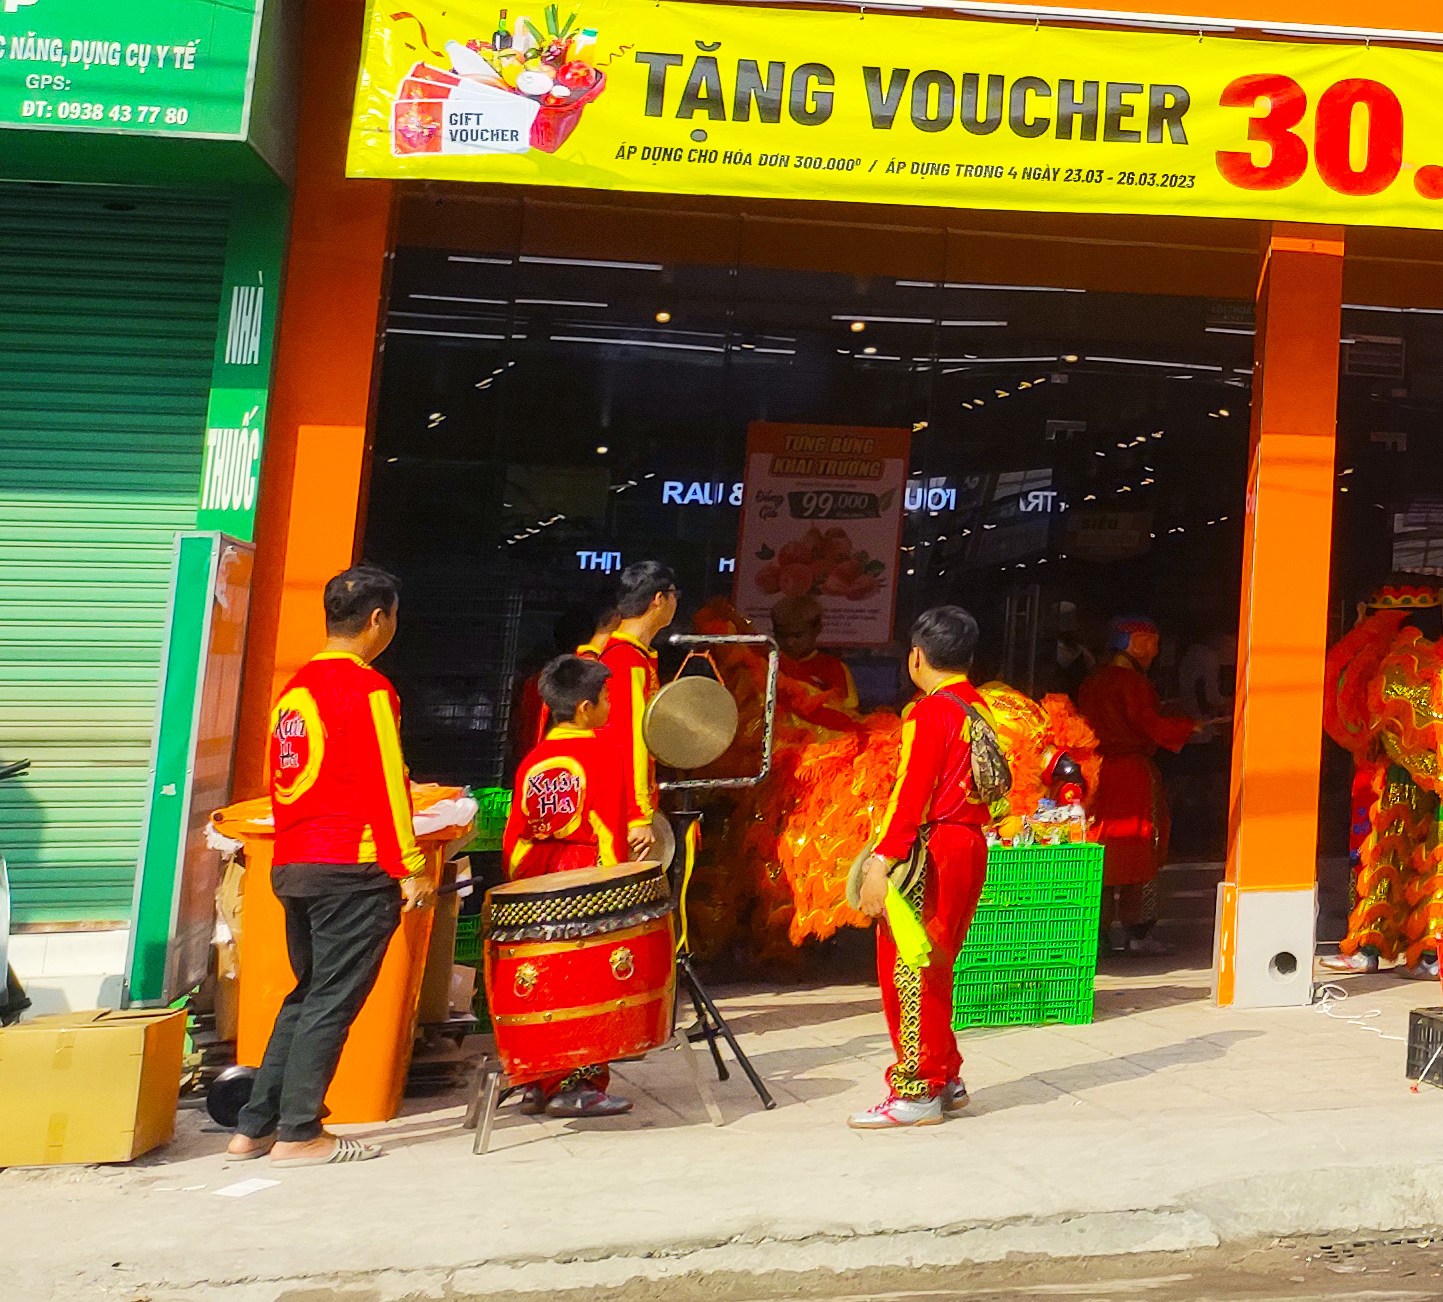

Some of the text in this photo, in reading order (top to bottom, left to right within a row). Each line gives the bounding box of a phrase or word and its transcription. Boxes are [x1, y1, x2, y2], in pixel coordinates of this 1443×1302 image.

[126, 39, 201, 73] CỤ Y TẾ
[26, 74, 71, 90] GPS:
[636, 40, 835, 143] TẶNG
[862, 66, 1192, 146] VOUCHER
[22, 100, 188, 125] ĐT: 0938 43 77 80
[449, 111, 520, 144] GIFT VOUCHER
[614, 141, 1197, 189] ÁP DỤNG CHO HÓA ĐƠN ÁP DỤNG TRONG 4 NGÀY 23.03 26.03.2023
[201, 405, 259, 511] THUỐC
[662, 480, 725, 506] RAU
[801, 492, 870, 517] 99.000
